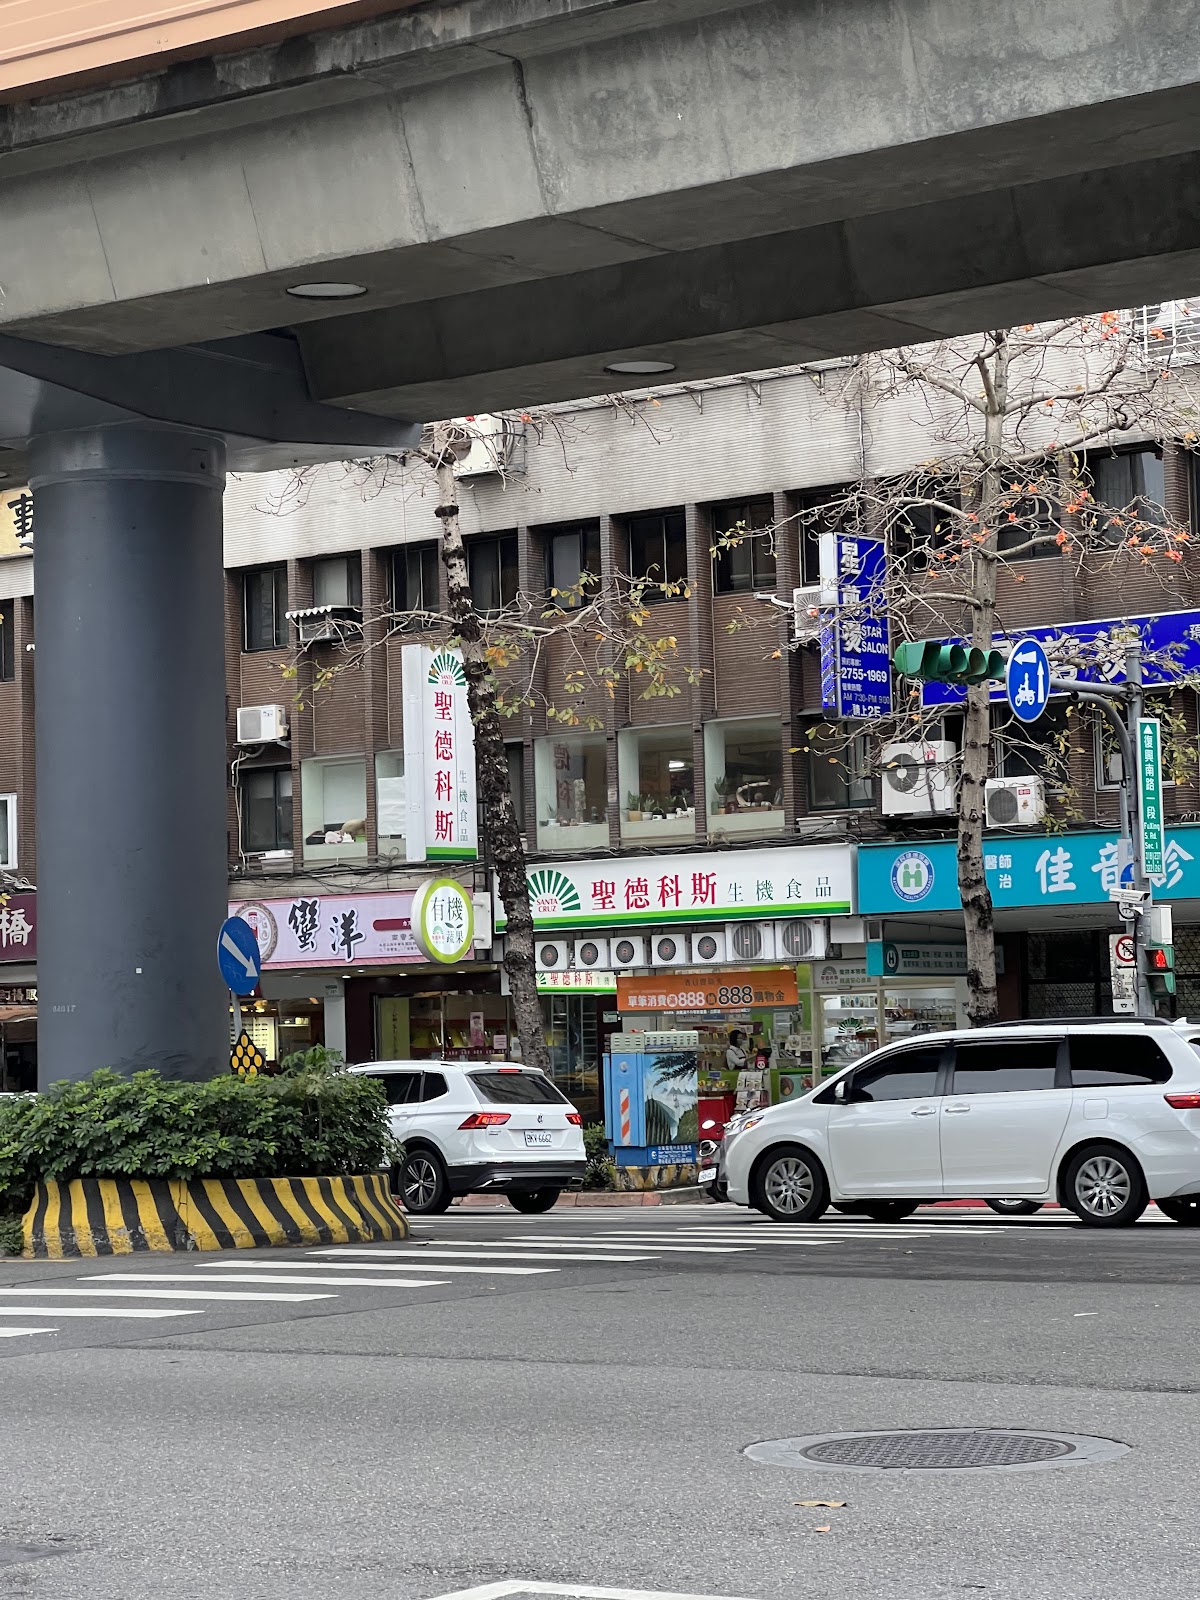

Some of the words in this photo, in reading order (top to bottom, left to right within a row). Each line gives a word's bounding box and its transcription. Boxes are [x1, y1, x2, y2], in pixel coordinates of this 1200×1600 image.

[861, 624, 882, 639] STAR
[861, 641, 889, 655] SALON
[841, 666, 888, 683] 2755-1969
[843, 692, 853, 701] AM
[434, 691, 453, 843] 聖德科斯
[1144, 735, 1156, 820] 復興南路一段
[459, 769, 468, 842] 生機食品
[1145, 842, 1154, 850] Sec.
[984, 854, 1012, 870] 醫師
[591, 872, 717, 911] 聖德科斯
[727, 876, 832, 903] 生機食品
[431, 896, 464, 922] 有機
[536, 898, 558, 906] SANTA
[538, 905, 557, 913] CRUZ
[446, 930, 464, 944] 蔬果
